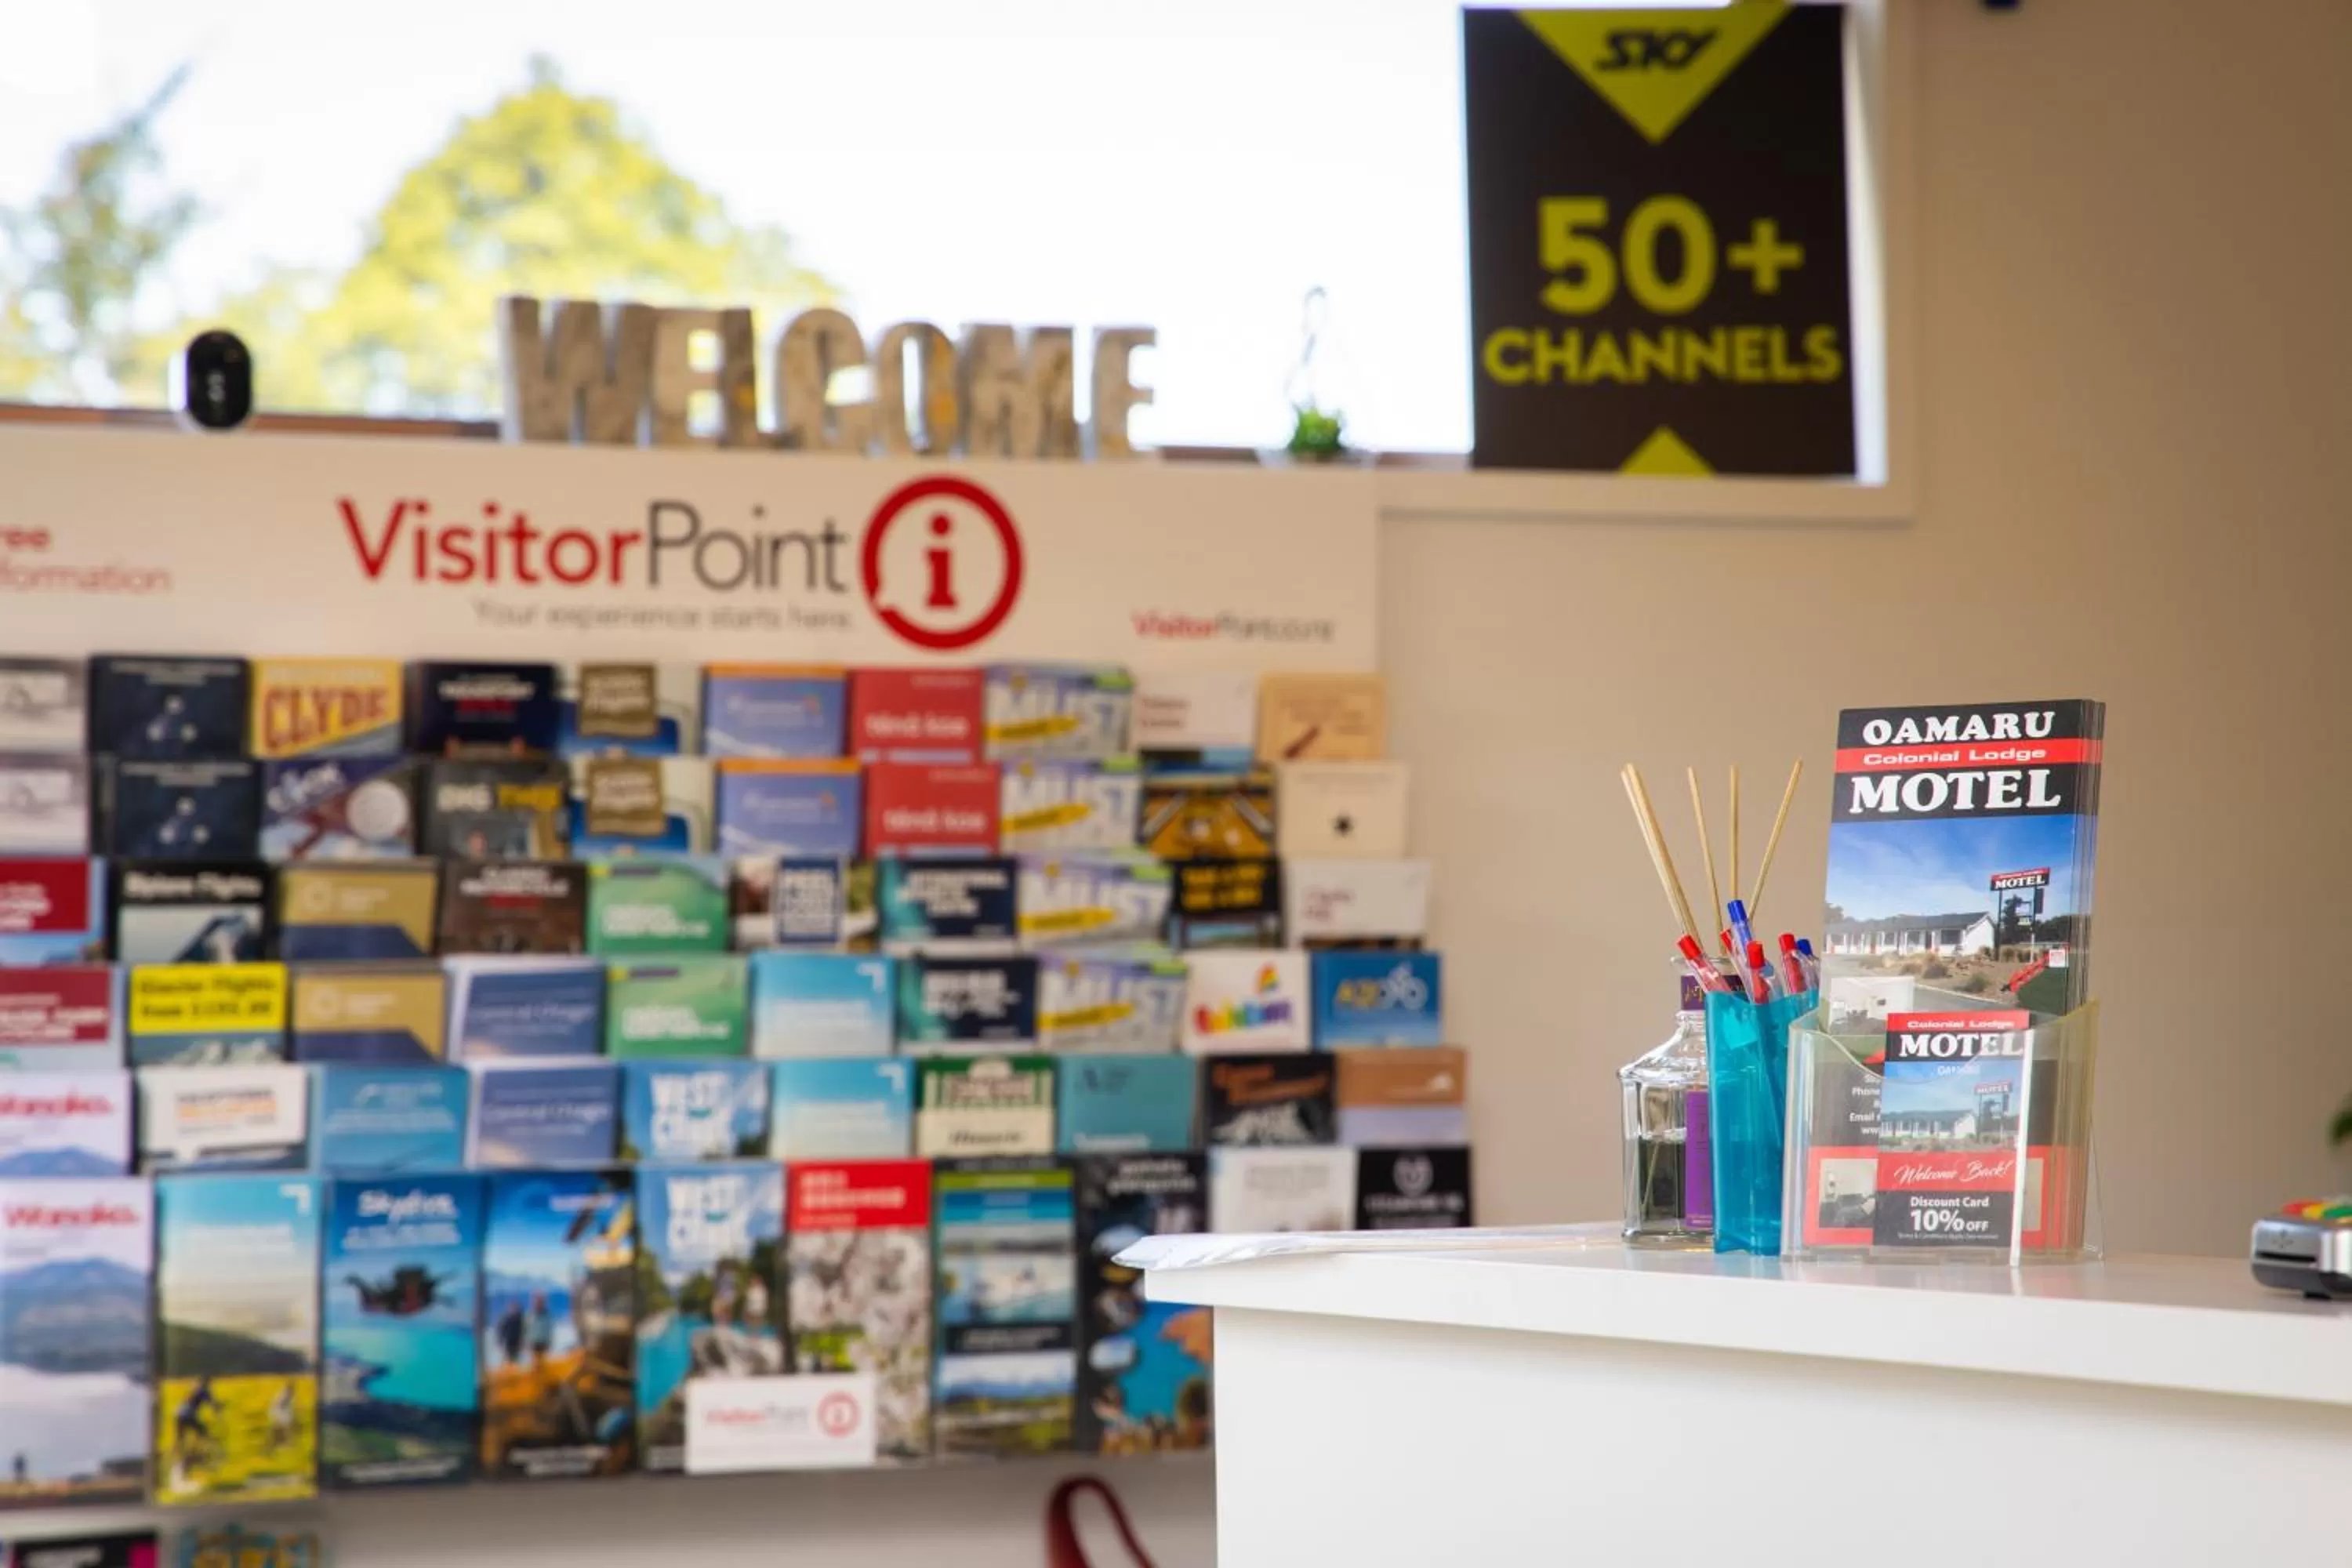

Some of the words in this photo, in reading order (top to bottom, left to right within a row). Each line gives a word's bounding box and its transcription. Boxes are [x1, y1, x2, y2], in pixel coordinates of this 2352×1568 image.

[1594, 28, 1720, 71] SKY
[1537, 194, 1802, 315] 50+
[1483, 325, 1842, 384] CHANNELS
[500, 296, 1157, 461] WELCOME
[263, 687, 390, 754] CLYDE
[1862, 711, 2056, 745] OAMARU
[1864, 750, 1960, 766] Colonial
[1969, 746, 2047, 763] Lodge
[1849, 768, 2062, 815] MOTEL
[1994, 874, 2045, 890] MOTEL
[1907, 1021, 1965, 1029] Colonial
[1969, 1020, 2016, 1030] Lodge
[1898, 1032, 2024, 1058] MOTEL
[1851, 1086, 1881, 1097] Phone
[1849, 1112, 1875, 1123] Email
[1894, 1163, 1958, 1186] Welcome
[1960, 1159, 2015, 1182] Back!
[1910, 1196, 1961, 1208] Discount
[1962, 1196, 1990, 1208] Card
[1910, 1209, 1965, 1232] 10%
[1965, 1220, 1990, 1232] OFF
